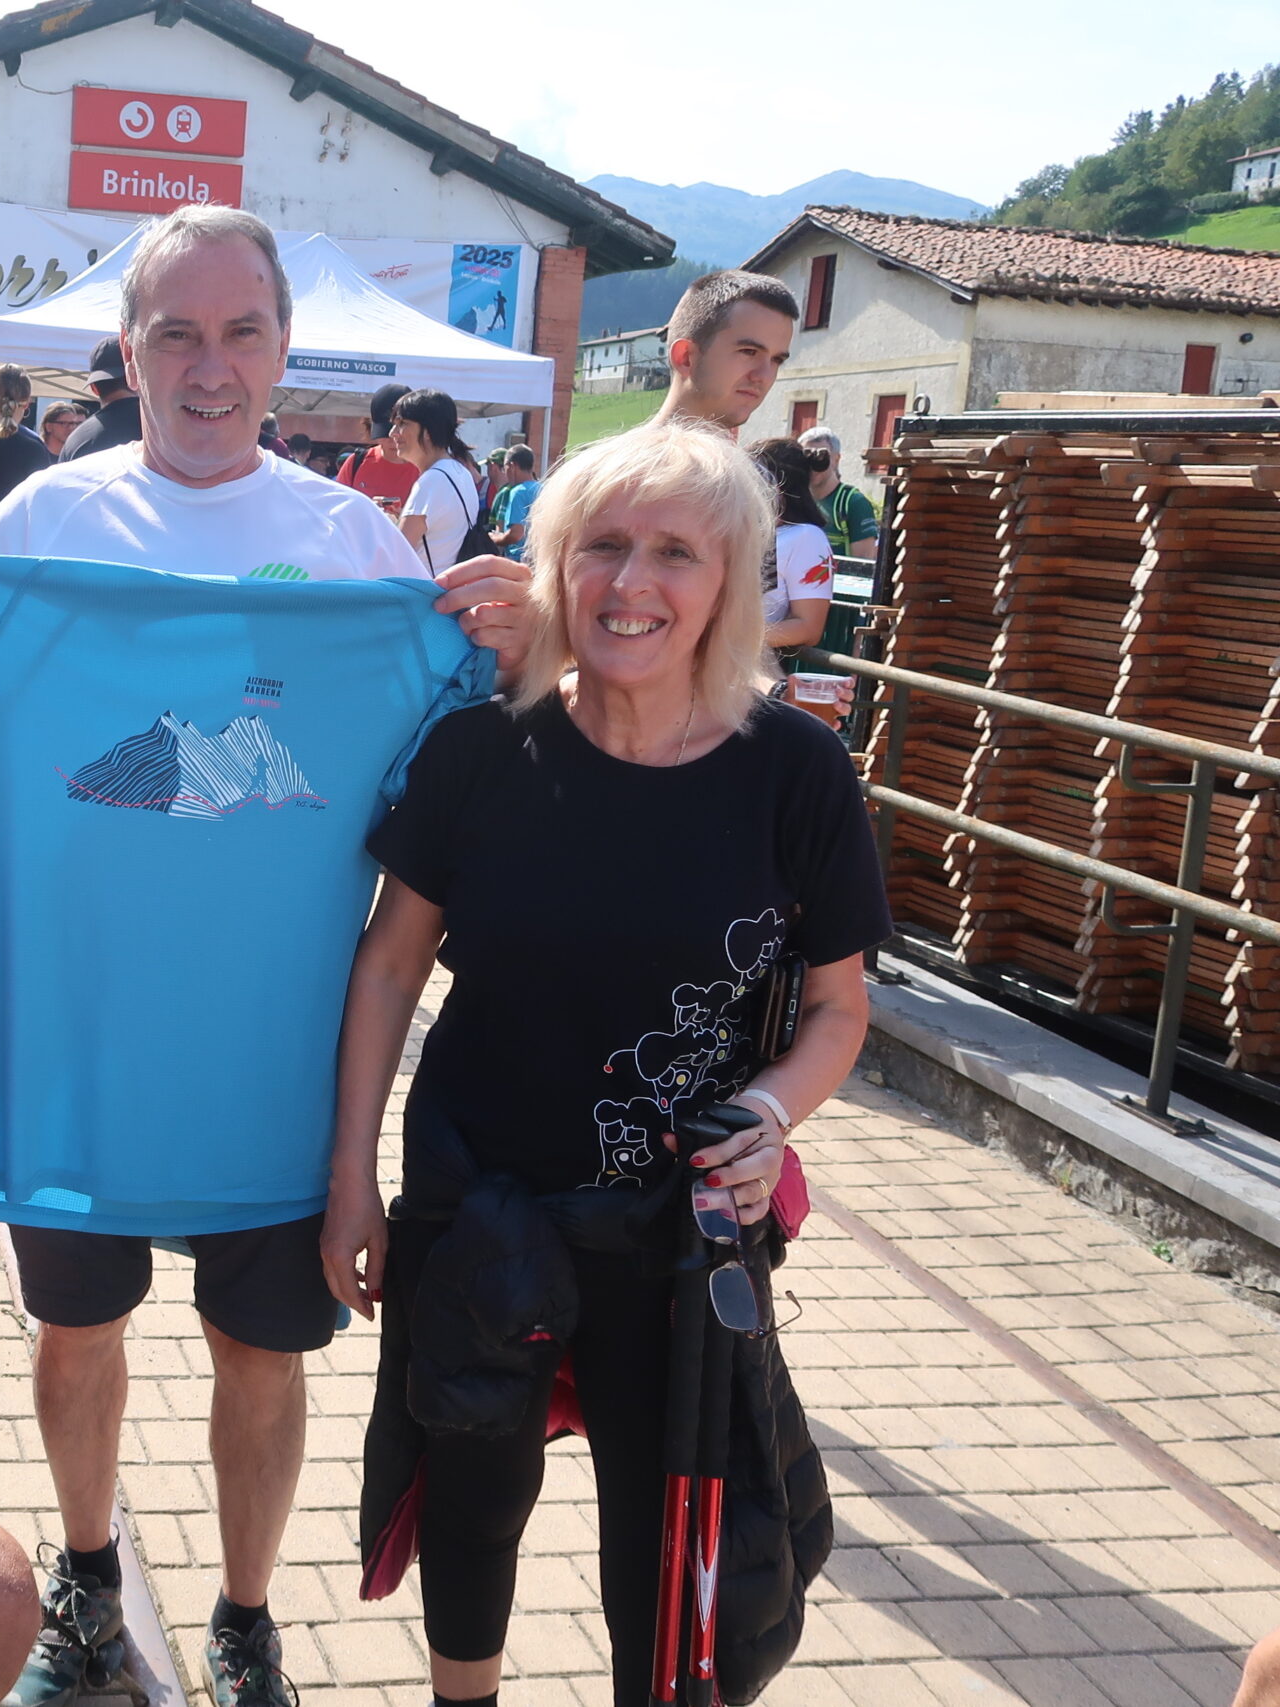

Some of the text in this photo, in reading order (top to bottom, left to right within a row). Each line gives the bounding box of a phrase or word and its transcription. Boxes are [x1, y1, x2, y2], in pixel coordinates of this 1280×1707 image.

[102, 169, 210, 203] Brinkola
[459, 244, 515, 269] 2025
[296, 357, 387, 373] GOBIERNO VASCO
